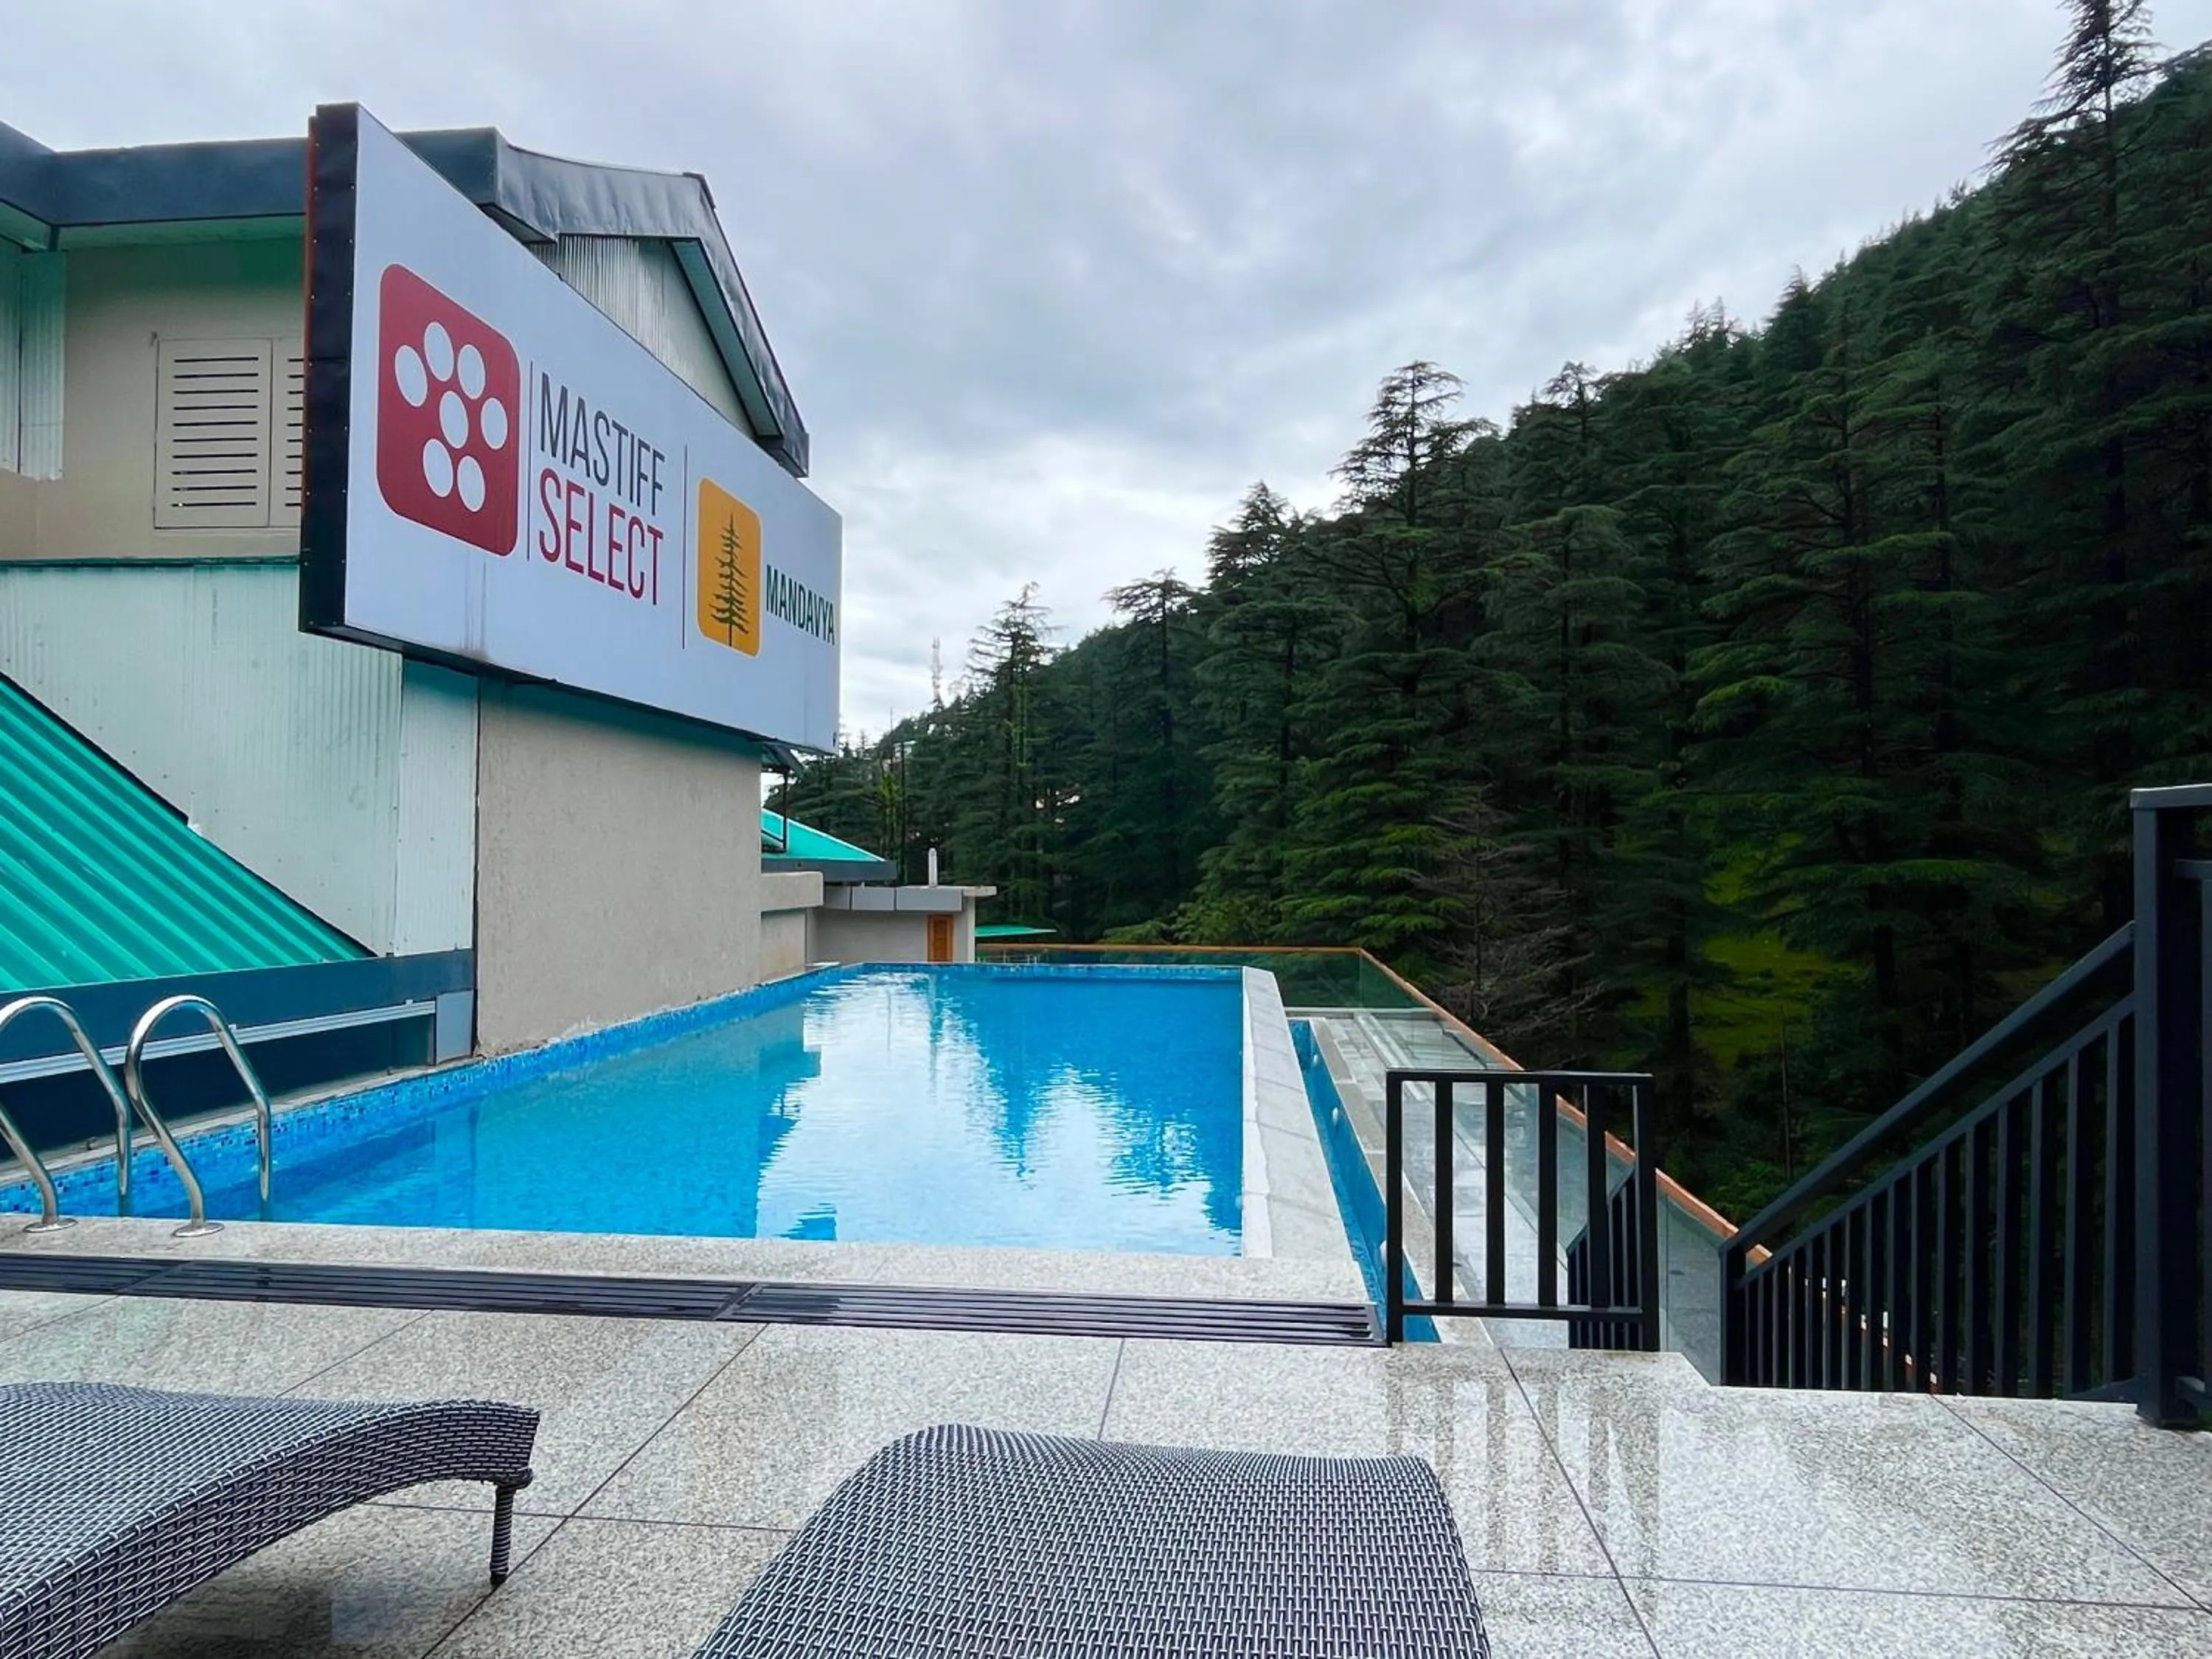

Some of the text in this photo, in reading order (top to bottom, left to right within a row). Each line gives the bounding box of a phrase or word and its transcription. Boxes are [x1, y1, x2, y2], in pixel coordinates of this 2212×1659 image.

[540, 372, 665, 515] MASTIFF
[539, 467, 663, 605] SELECT
[766, 565, 835, 644] MANDAVYA
